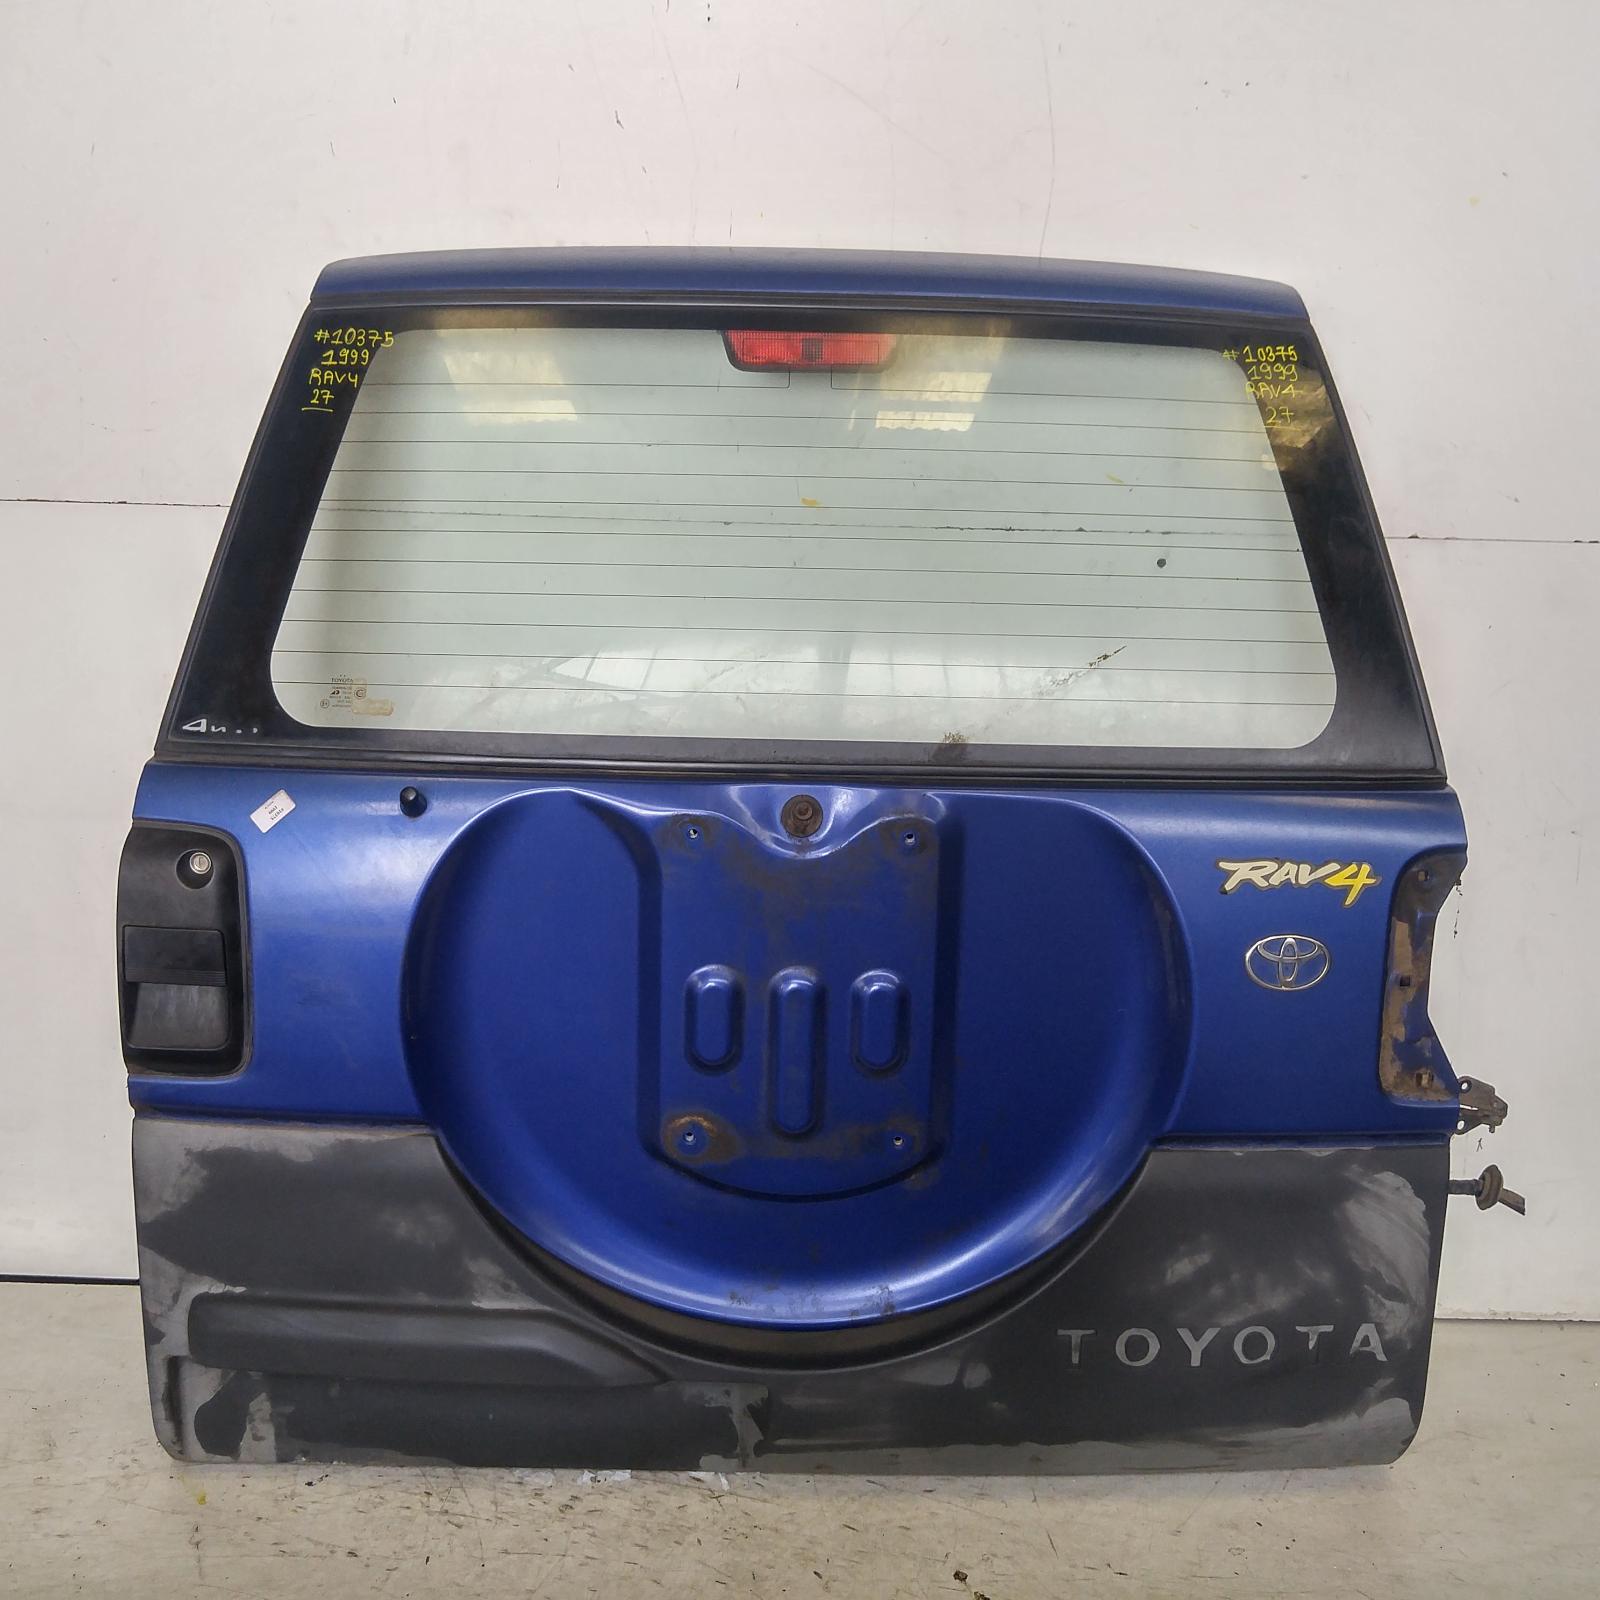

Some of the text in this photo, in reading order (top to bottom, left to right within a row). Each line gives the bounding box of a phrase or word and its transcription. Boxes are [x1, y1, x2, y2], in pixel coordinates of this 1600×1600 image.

[314, 327, 395, 348] #10375
[321, 347, 370, 366] 1999
[1222, 345, 1298, 362] #10375
[309, 367, 359, 389] RAV4
[1247, 362, 1298, 382] 1999
[310, 388, 335, 405] 27
[1245, 381, 1304, 401] RAV4
[1265, 406, 1295, 424] 27
[1218, 860, 1378, 906] RAV4
[1056, 1322, 1389, 1368] TOYOTA
